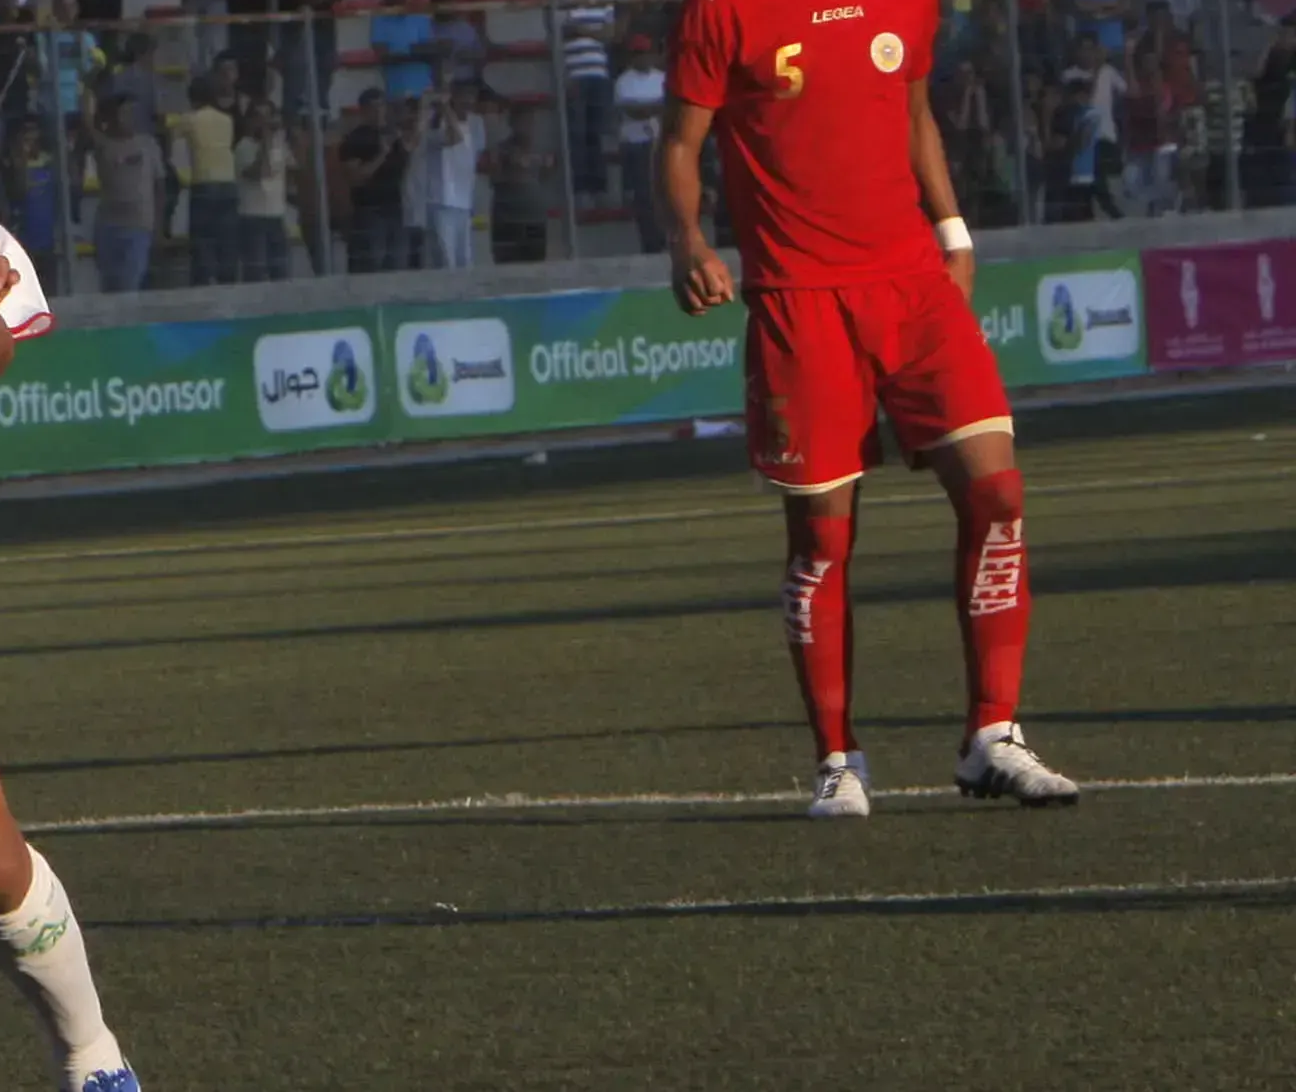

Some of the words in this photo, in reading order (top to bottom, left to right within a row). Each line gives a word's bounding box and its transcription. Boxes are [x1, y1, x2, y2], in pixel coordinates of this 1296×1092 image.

[811, 6, 865, 24] LEGEA
[774, 42, 804, 99] 5
[528, 337, 628, 383] Official
[631, 335, 738, 384] Sponsor
[107, 376, 226, 426] Sponsor
[262, 366, 320, 405] جوال
[969, 540, 1021, 618] LEGEA
